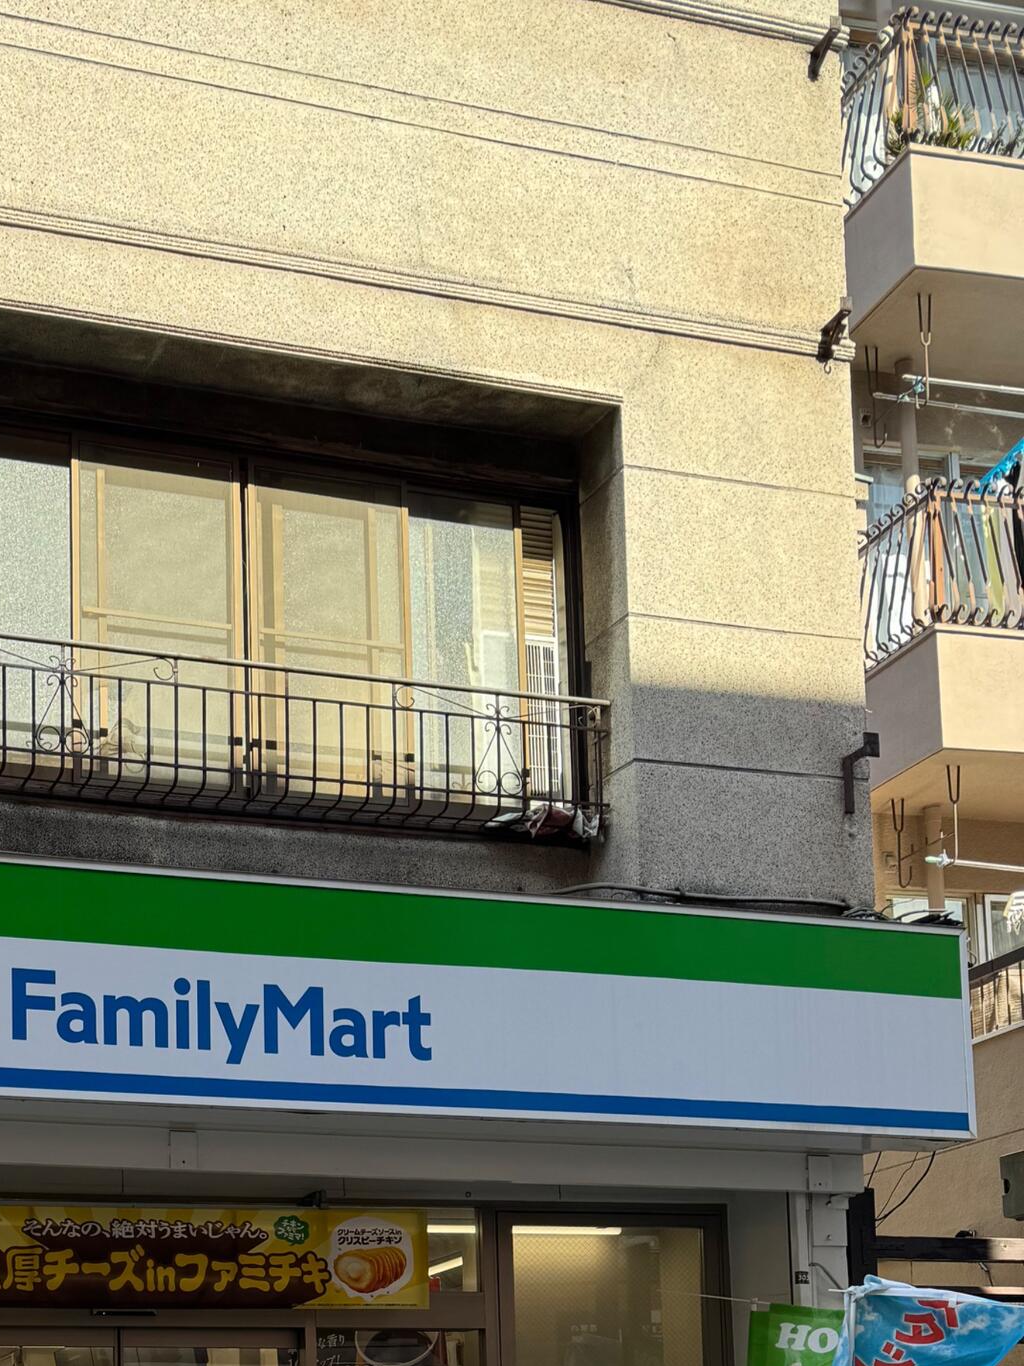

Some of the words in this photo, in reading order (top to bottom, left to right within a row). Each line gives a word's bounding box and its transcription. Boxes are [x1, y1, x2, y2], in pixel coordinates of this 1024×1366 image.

[11, 967, 432, 1064] FamilyMart
[22, 1218, 269, 1240] そんなの、絶対うまいじゃん。
[337, 1235, 403, 1246] クリスピーチキン
